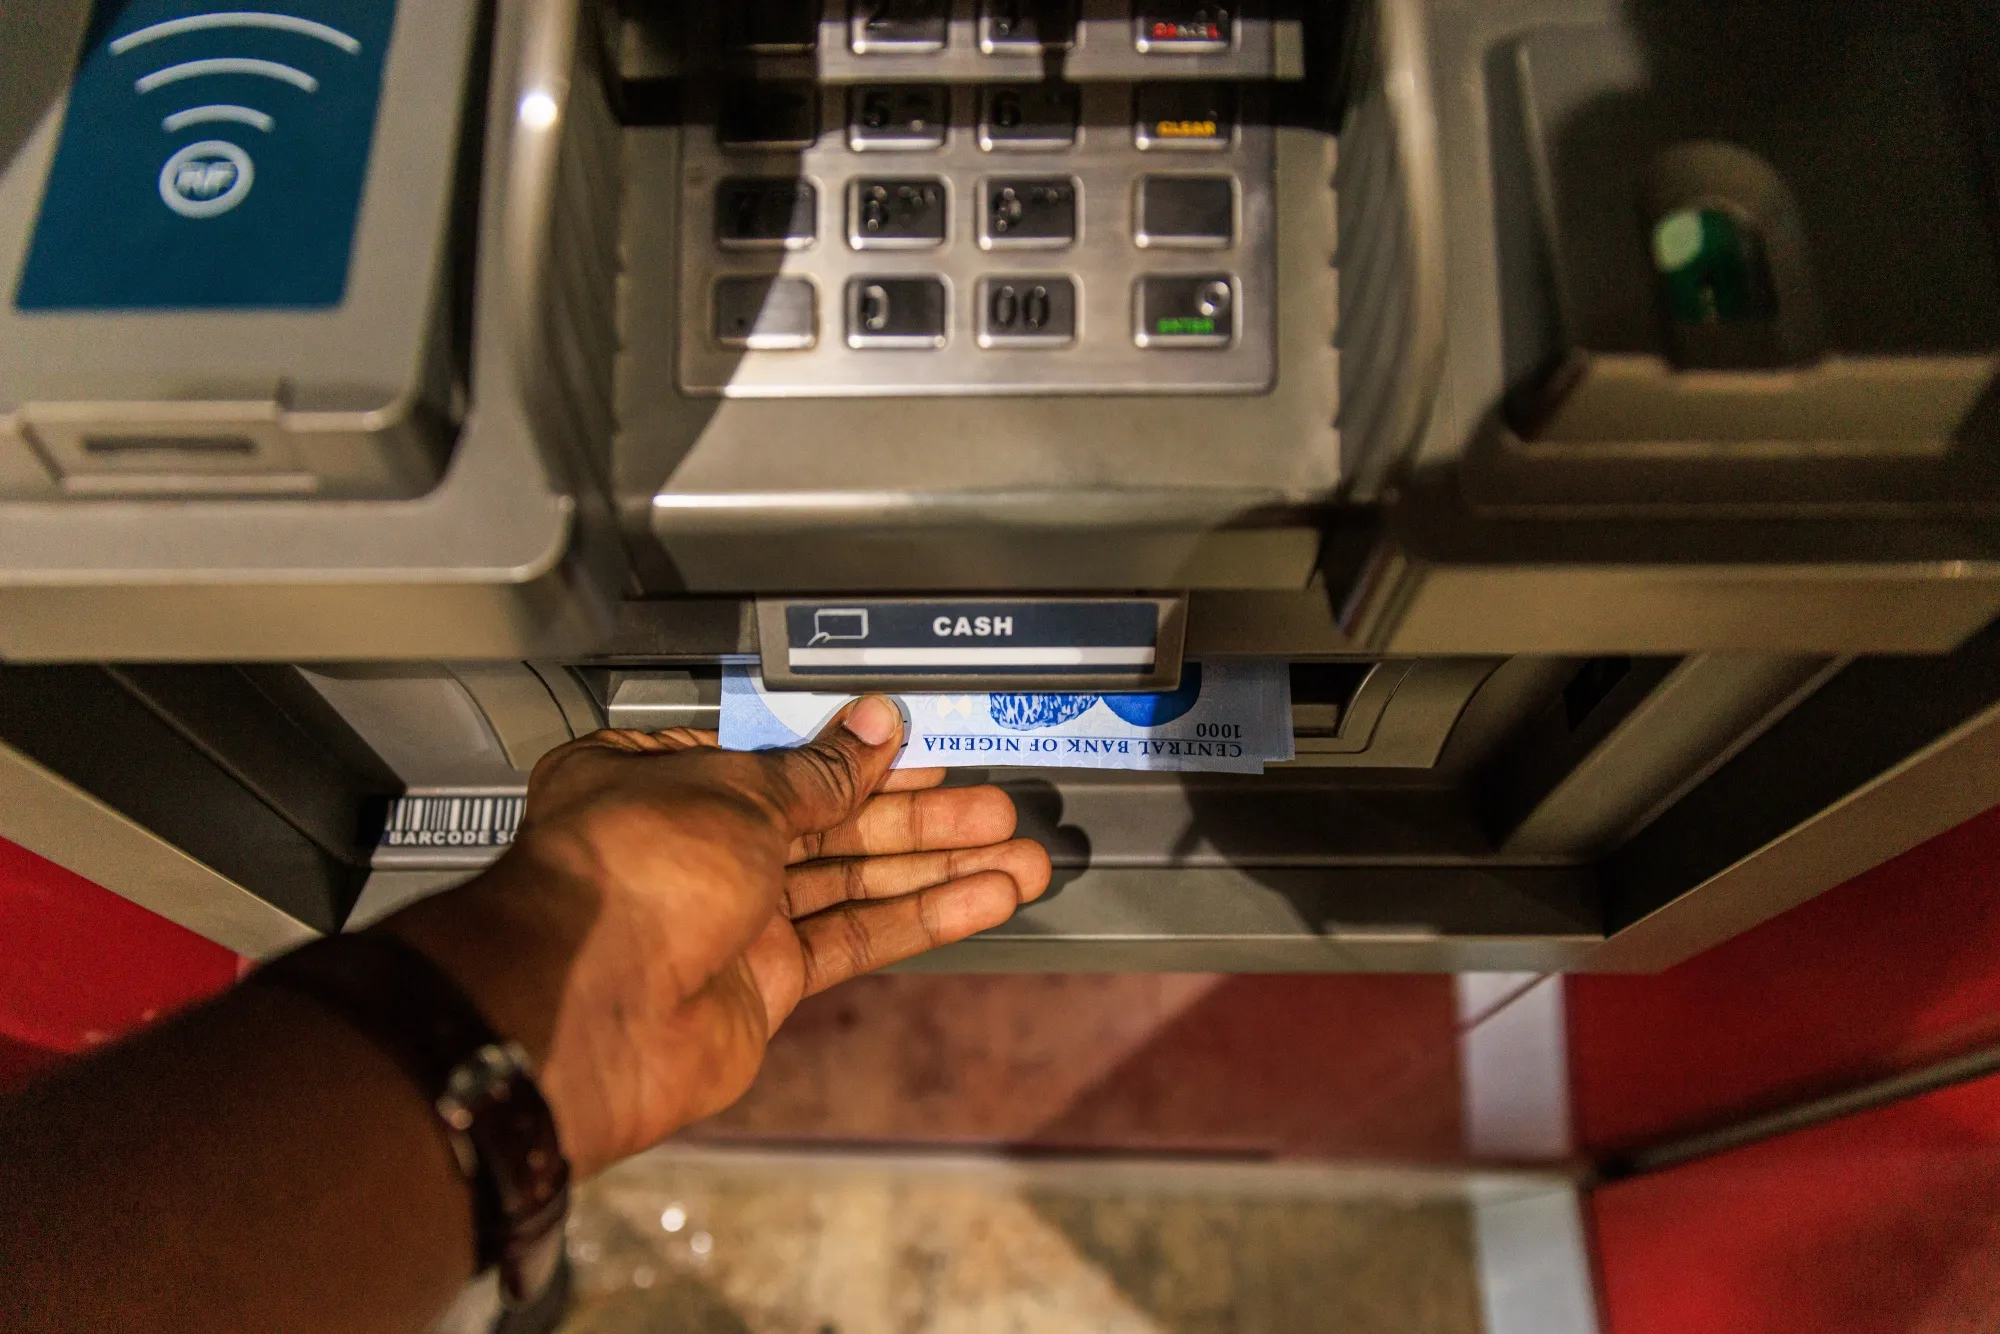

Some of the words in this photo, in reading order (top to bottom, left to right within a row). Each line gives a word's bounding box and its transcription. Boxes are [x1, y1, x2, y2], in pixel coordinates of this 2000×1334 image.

[1156, 120, 1217, 136] CLEAR
[991, 285, 1050, 330] 00
[932, 615, 1013, 637] CASH
[1196, 723, 1242, 739] 1000
[923, 737, 1020, 751] NIGERIA
[1029, 739, 1058, 752] OF
[1067, 739, 1129, 753] BANK
[1138, 740, 1242, 757] CENTRAL
[388, 830, 491, 845] BARCODE
